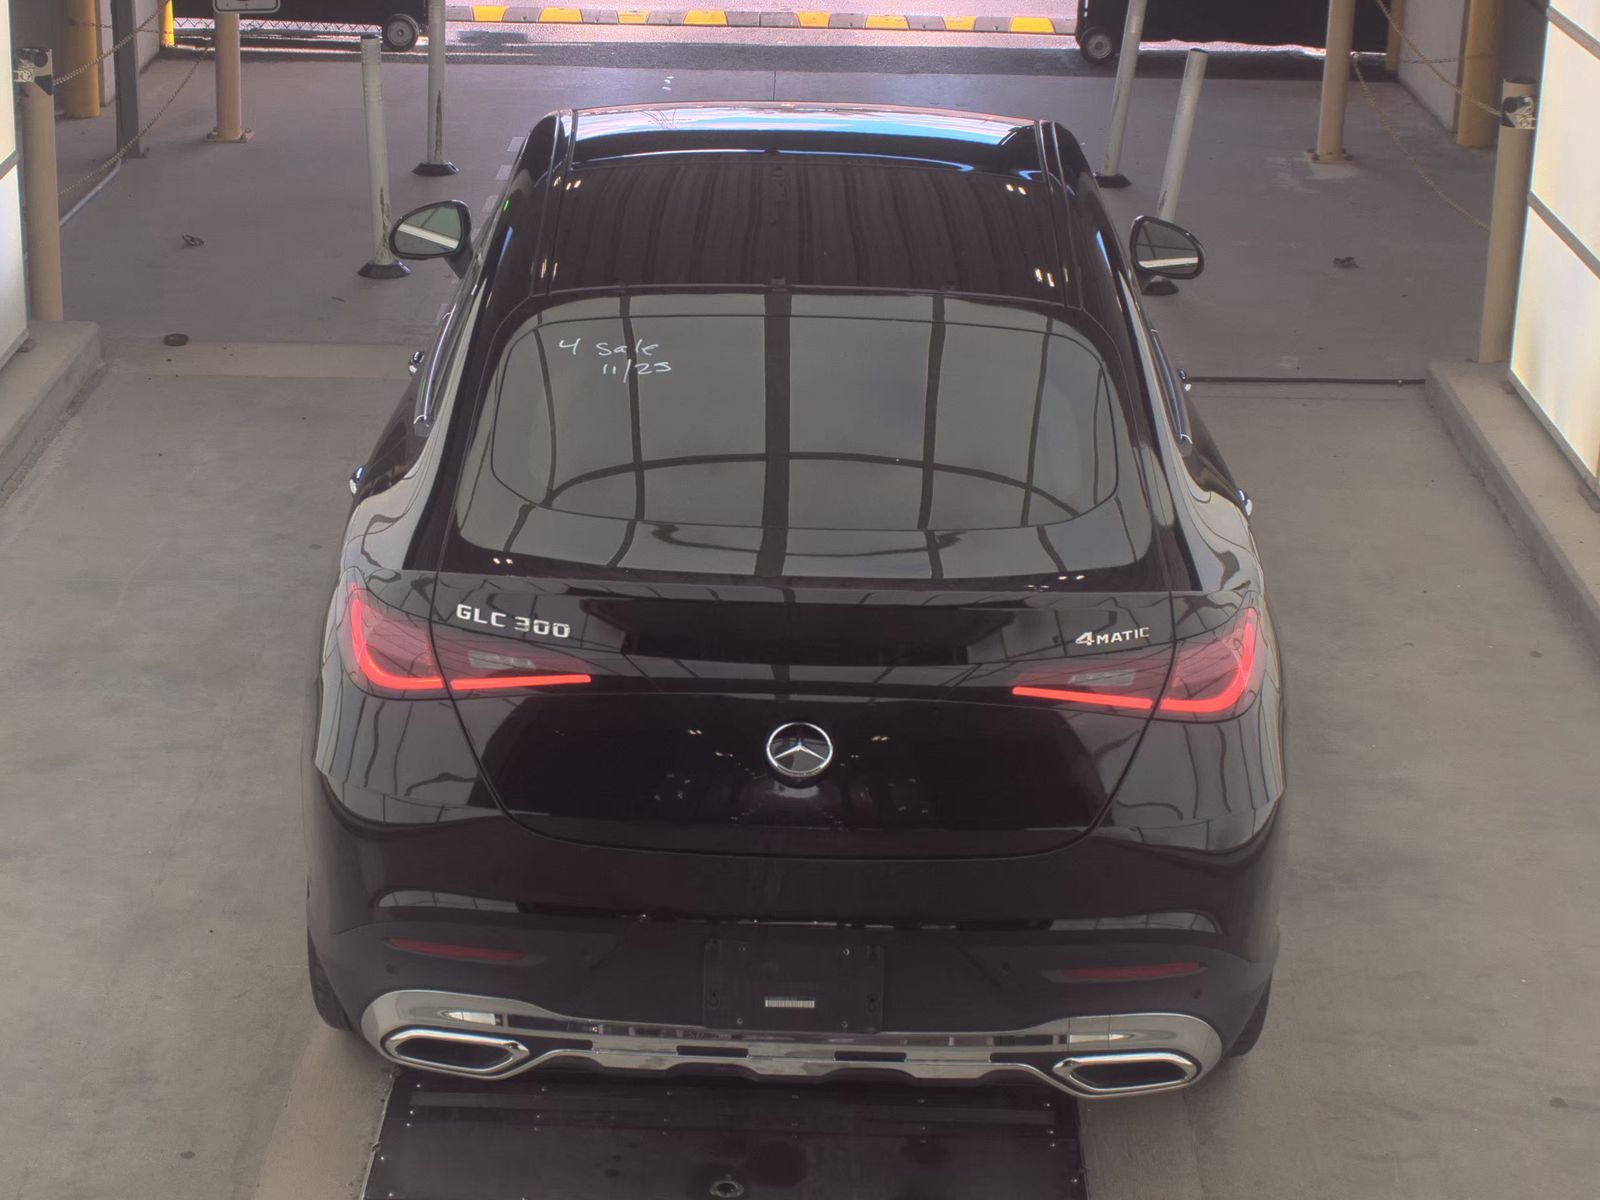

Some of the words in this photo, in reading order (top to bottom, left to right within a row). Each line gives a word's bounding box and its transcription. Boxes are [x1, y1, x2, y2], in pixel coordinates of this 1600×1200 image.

[559, 337, 581, 355] 4
[456, 603, 507, 628] GLC
[513, 615, 571, 638] 300
[1075, 626, 1150, 646] 4MATIC
